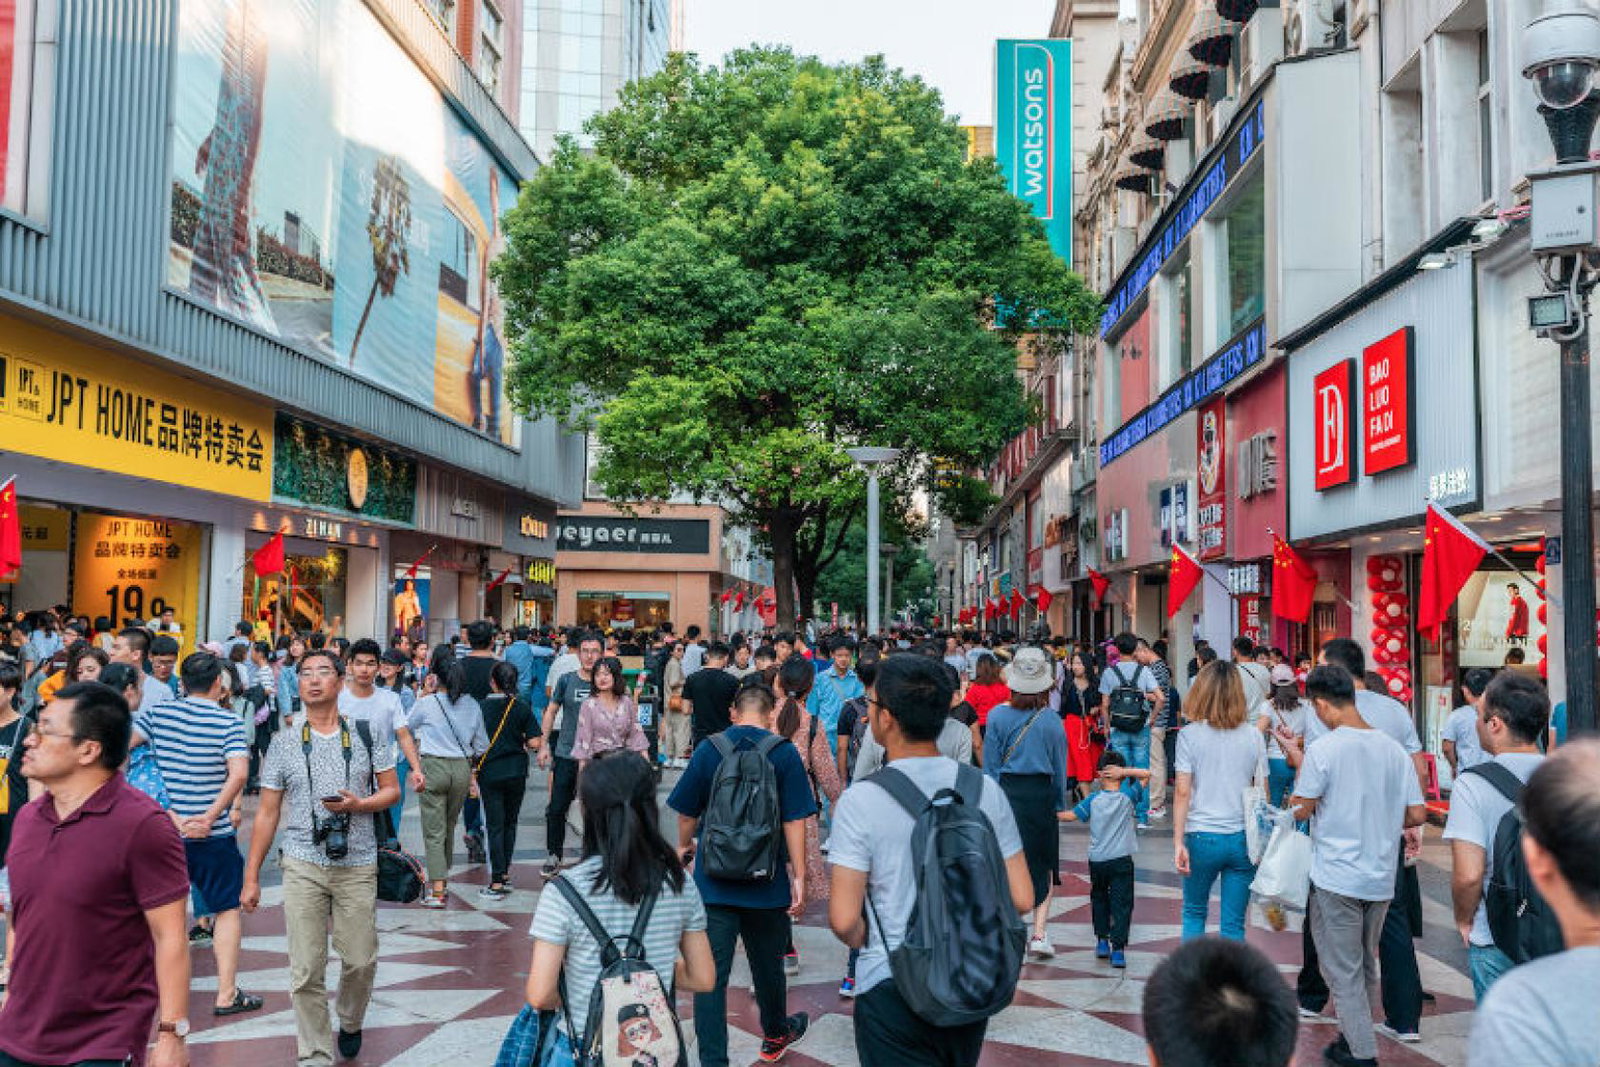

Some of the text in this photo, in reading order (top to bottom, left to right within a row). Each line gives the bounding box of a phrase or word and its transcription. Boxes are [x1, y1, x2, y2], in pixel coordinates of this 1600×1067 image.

[1023, 68, 1043, 196] watsons
[1370, 358, 1389, 385] BAO
[47, 371, 154, 447] JPT HOME
[1369, 385, 1389, 411] LUO
[158, 402, 264, 473] 品牌特卖会
[106, 521, 172, 538] JPT HOME
[95, 541, 180, 559] 品牌特卖会
